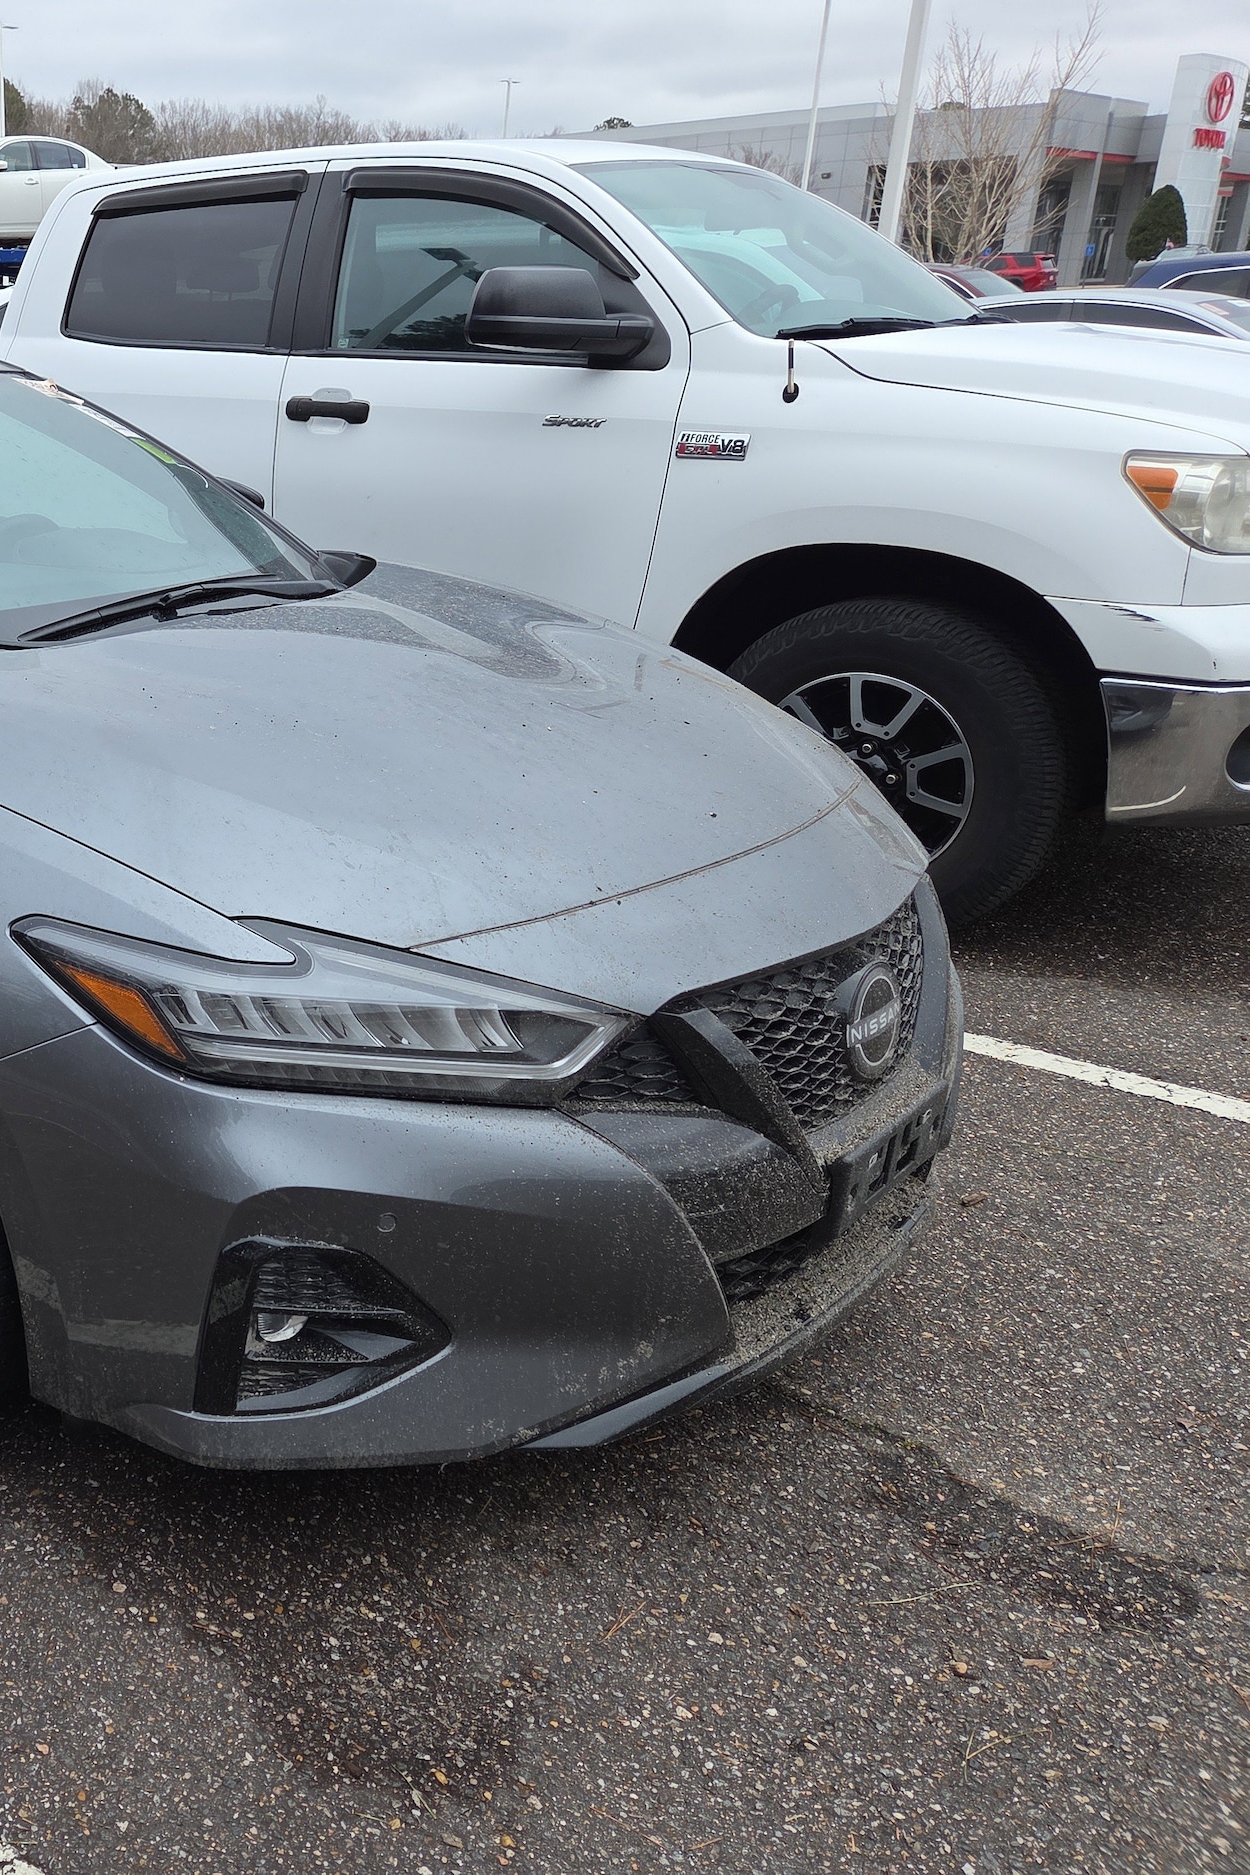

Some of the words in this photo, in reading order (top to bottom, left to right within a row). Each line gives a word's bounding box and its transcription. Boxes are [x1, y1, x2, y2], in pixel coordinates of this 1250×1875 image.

[542, 414, 607, 428] SPORT
[720, 438, 746, 454] V8
[850, 1002, 900, 1043] NISSAN
